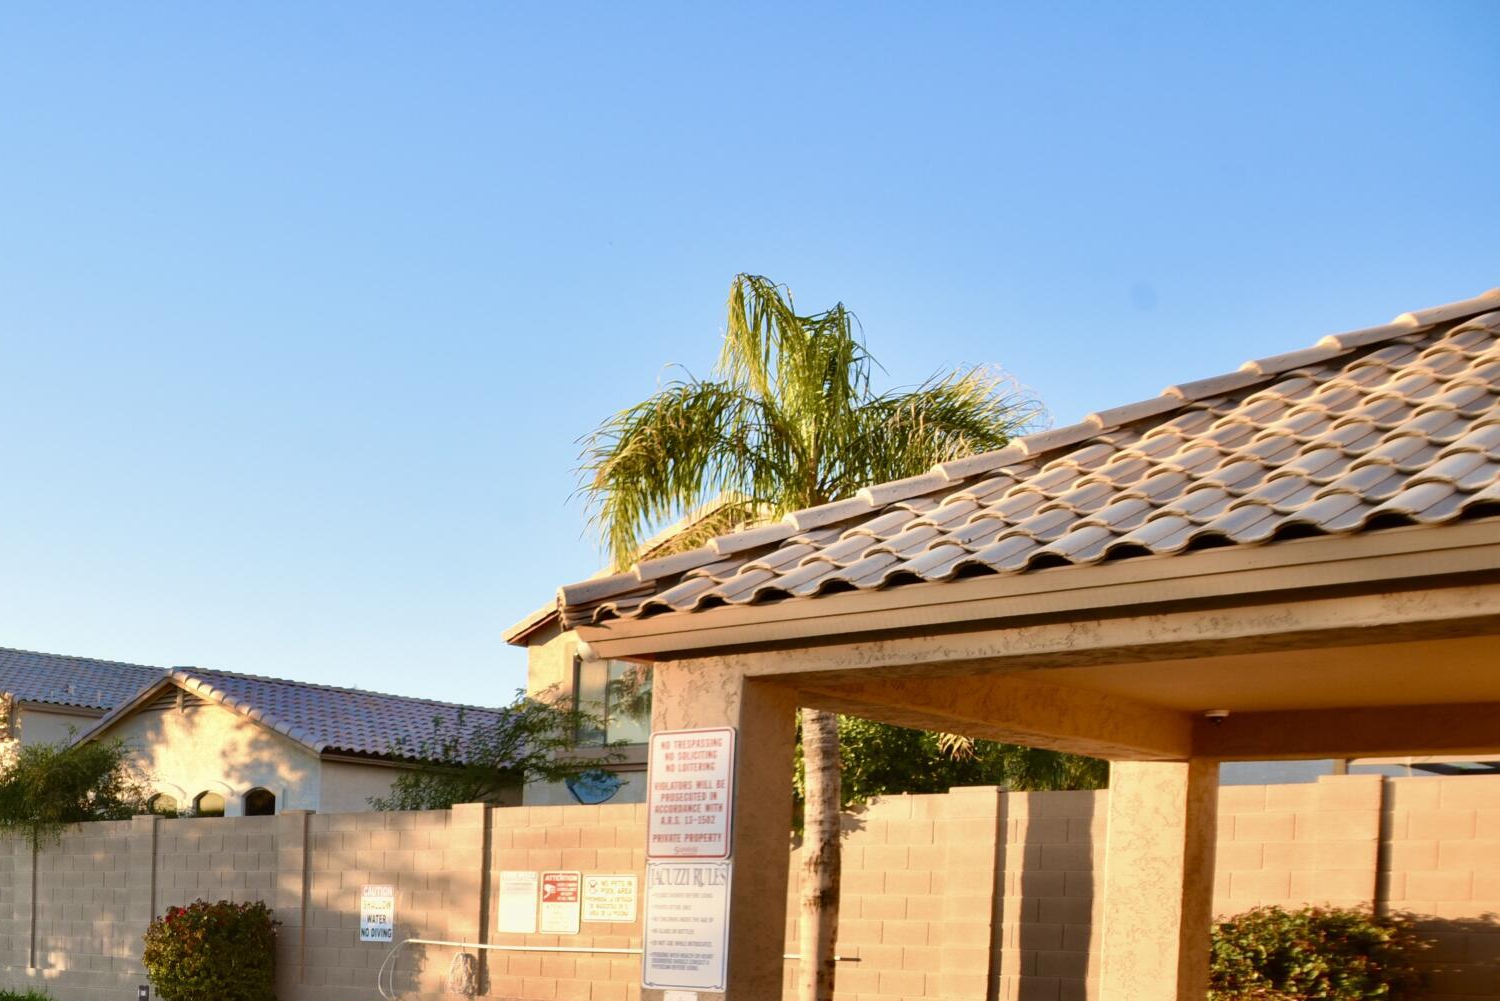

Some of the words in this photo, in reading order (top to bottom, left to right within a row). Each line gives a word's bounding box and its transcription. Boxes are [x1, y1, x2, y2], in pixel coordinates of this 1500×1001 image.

[674, 739, 722, 748] TRESPASSING
[664, 752, 674, 760] NO
[677, 750, 718, 760] SOLICITING
[665, 764, 675, 773] NO
[678, 762, 716, 772] LOITERING
[654, 781, 693, 790] VIOLATORS
[695, 780, 713, 789] WILL
[716, 779, 725, 789] BE
[660, 791, 707, 801] PROSECUTED
[710, 791, 717, 800] IN
[654, 804, 701, 813] ACCORDANCE
[705, 804, 723, 812] WITH
[652, 833, 682, 843] PRIVATE
[684, 833, 722, 843] PROPERTY
[651, 868, 690, 886] JACUZZI
[693, 868, 726, 887] RULES
[363, 887, 393, 897] CAUTION
[363, 901, 391, 910] SHALLOW
[367, 914, 387, 924] WATER
[361, 928, 369, 937] NO
[371, 928, 392, 938] DIVING
